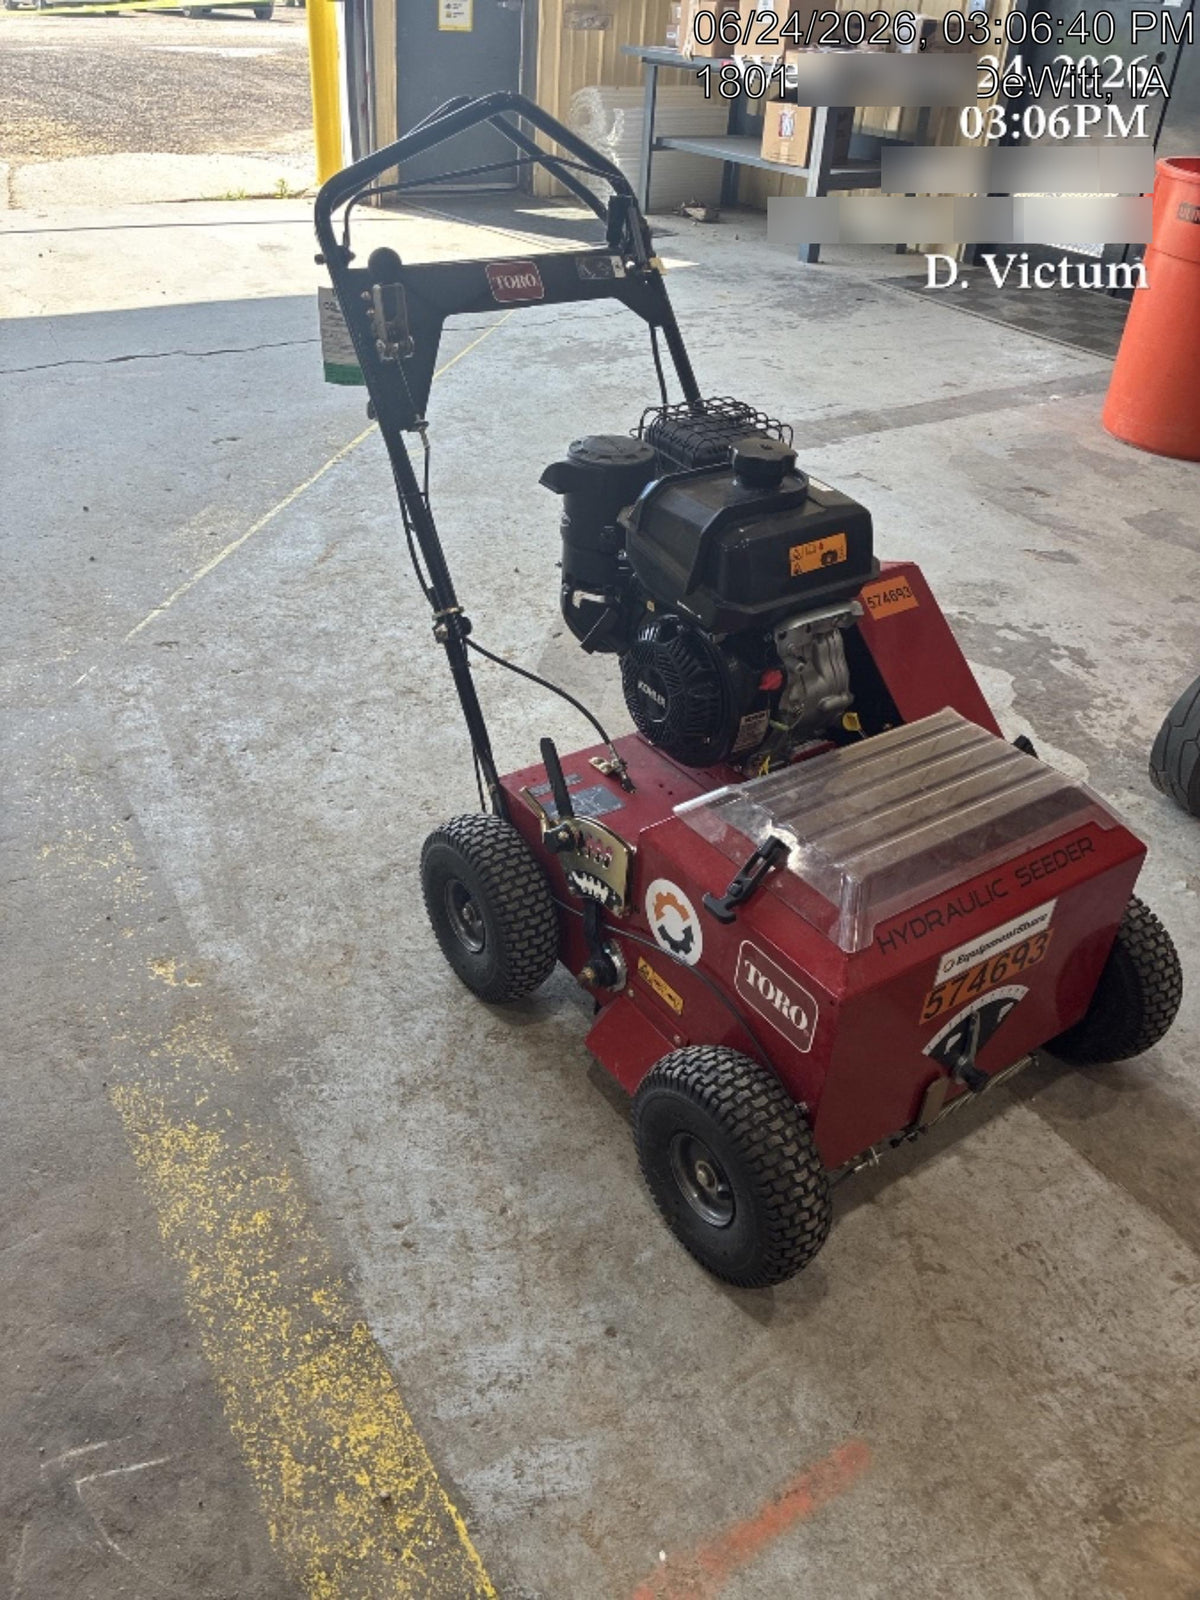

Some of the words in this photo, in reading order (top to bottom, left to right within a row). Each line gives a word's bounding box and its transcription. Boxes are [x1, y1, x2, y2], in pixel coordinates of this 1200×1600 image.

[492, 272, 538, 290] TORO
[866, 585, 913, 609] 574693
[876, 878, 1009, 955] HYDRAULIC
[1014, 836, 1095, 888] SEEDER
[744, 959, 809, 1031] TORO
[923, 930, 1050, 1020] 574693
